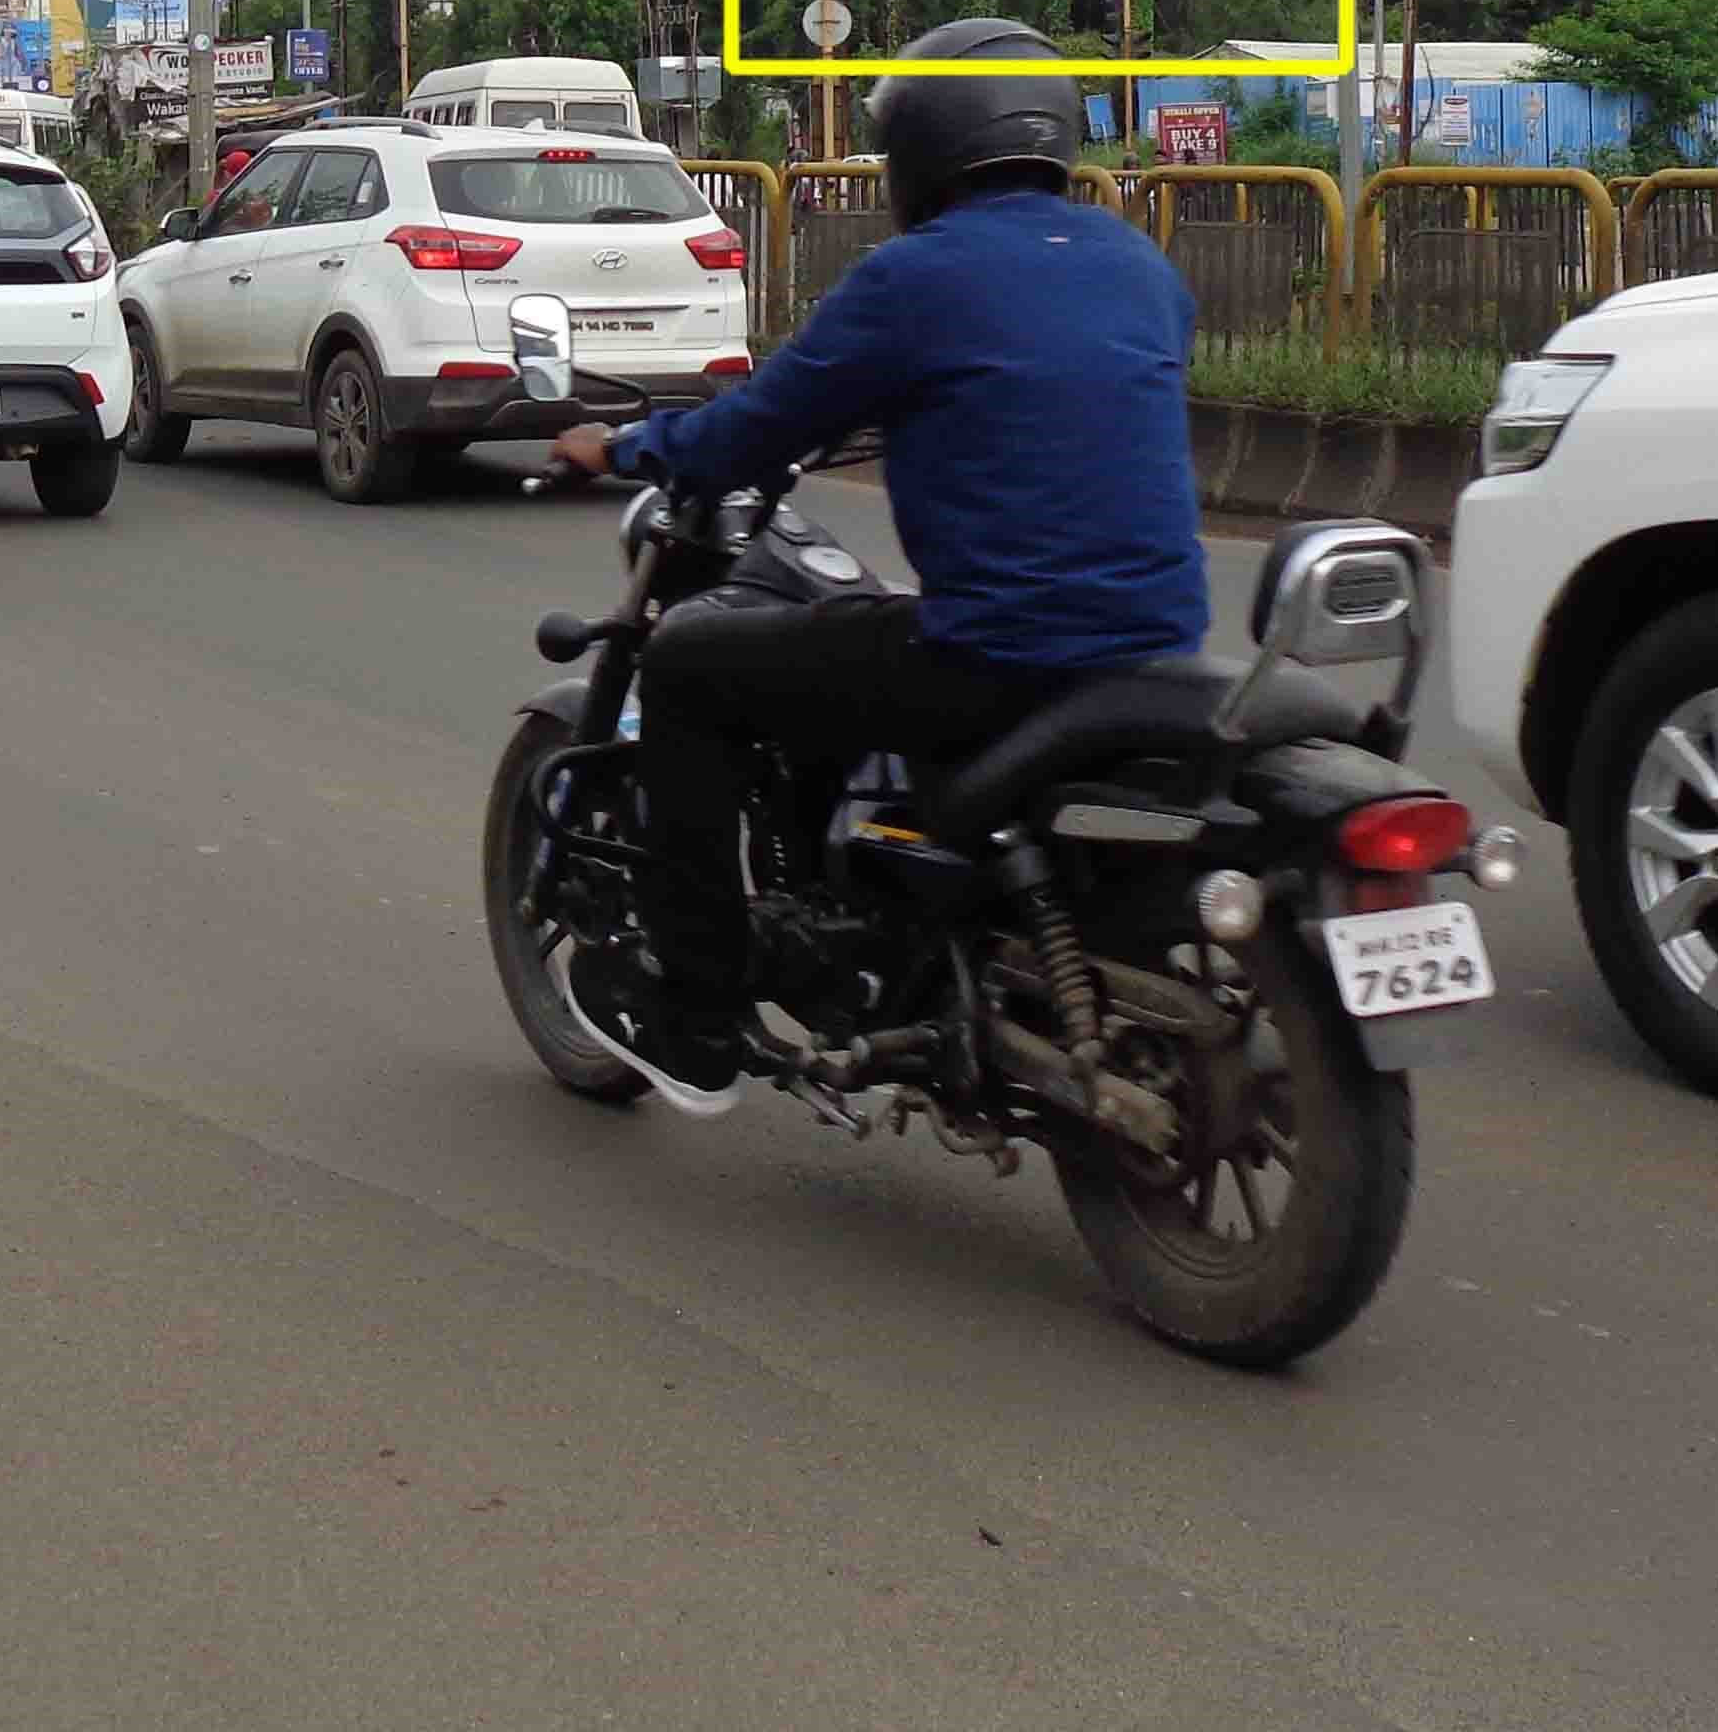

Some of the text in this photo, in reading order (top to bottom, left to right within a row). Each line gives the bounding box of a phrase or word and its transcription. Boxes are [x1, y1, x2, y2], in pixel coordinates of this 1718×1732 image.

[168, 51, 265, 69] WOPECKER
[1171, 127, 1216, 141] BUY 4
[1171, 139, 1204, 152] TAKE
[1356, 955, 1474, 1005] 7624
